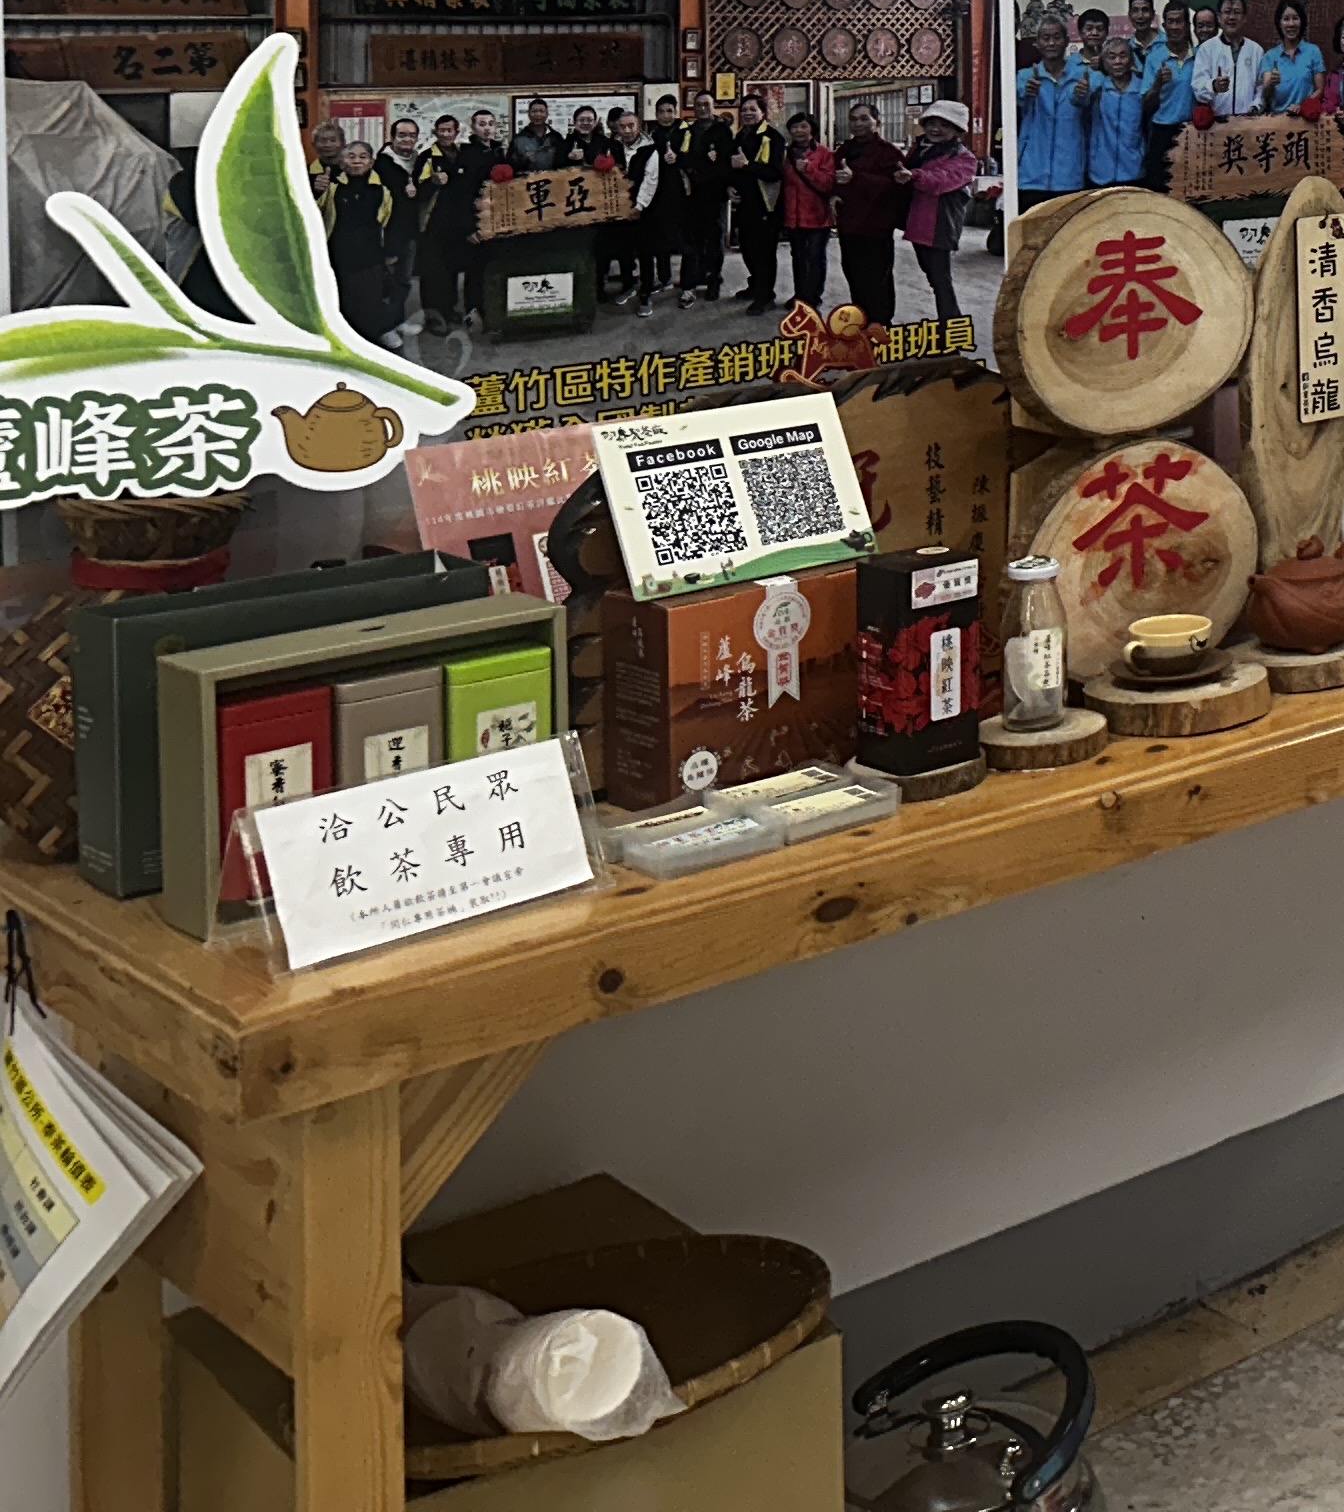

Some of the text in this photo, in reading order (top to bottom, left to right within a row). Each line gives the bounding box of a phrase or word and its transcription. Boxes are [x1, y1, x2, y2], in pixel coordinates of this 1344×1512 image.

[1063, 228, 1204, 361] 奉
[1308, 243, 1342, 416] 清香烏龍
[634, 443, 718, 469] Facebook
[737, 428, 816, 452] Google Map
[925, 442, 947, 541] 技藝精
[1072, 452, 1210, 592] 茶
[715, 634, 734, 687] 蘆峰
[736, 651, 760, 723] 烏龍茶
[318, 769, 519, 845] 洽公民眾
[330, 820, 526, 898] 飲茶專用
